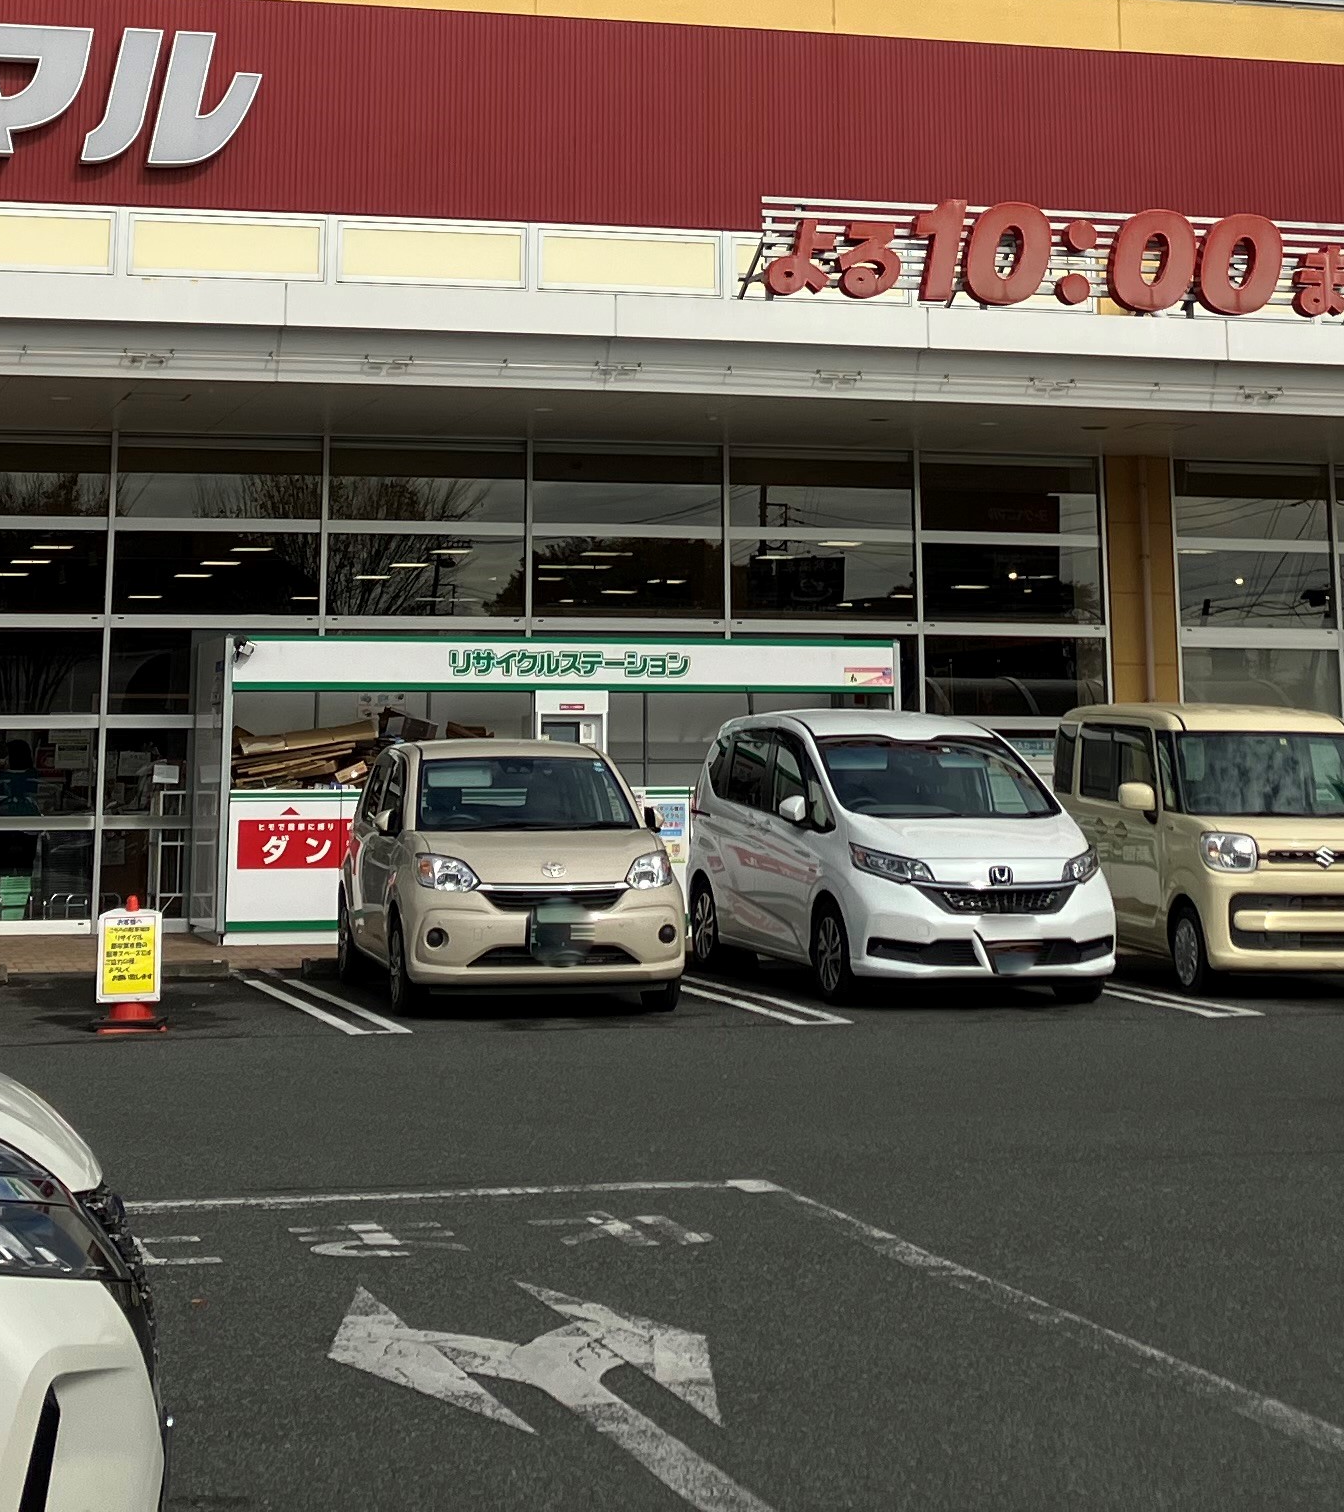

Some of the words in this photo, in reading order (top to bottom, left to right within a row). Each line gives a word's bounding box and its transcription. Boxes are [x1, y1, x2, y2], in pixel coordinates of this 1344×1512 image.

[449, 649, 691, 678] リサイクルステーション
[261, 834, 350, 865] ダン
